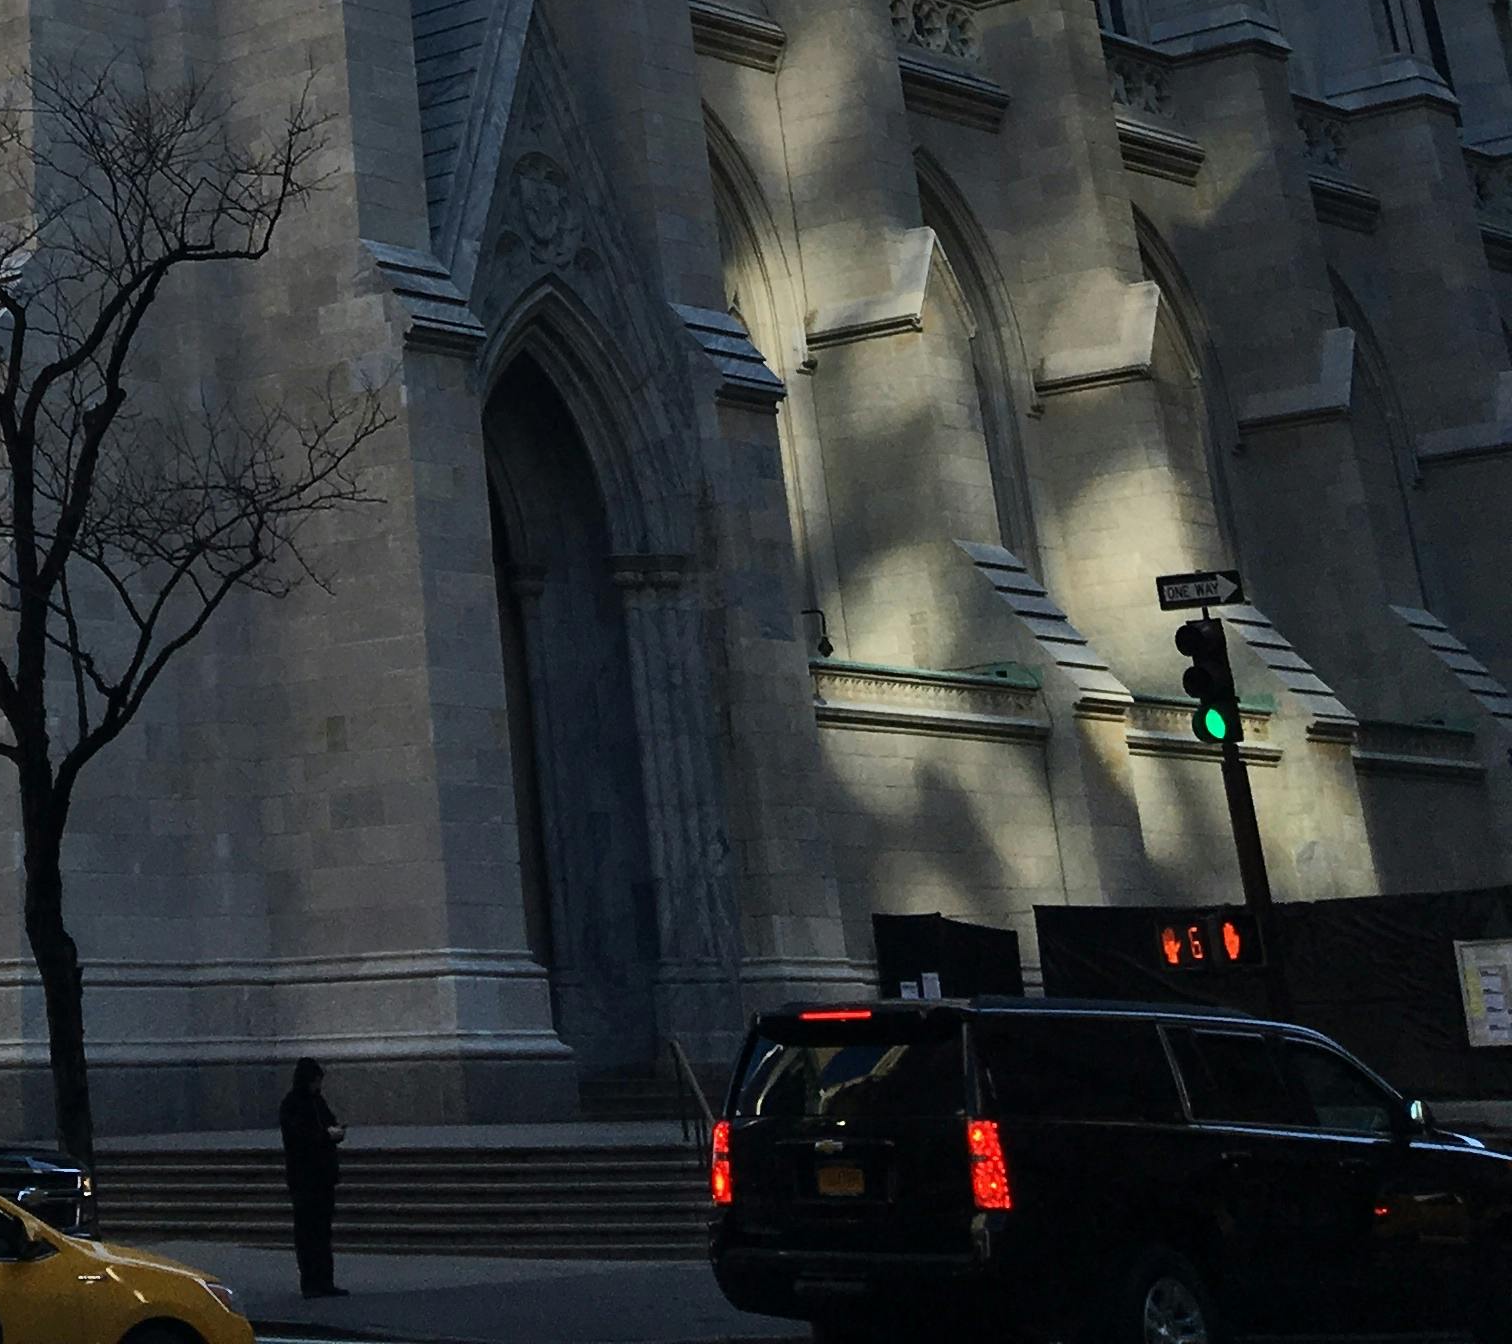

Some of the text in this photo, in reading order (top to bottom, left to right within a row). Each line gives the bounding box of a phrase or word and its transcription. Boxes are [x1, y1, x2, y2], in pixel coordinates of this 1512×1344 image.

[1167, 582, 1218, 599] ONE WAY
[1187, 925, 1204, 960] 6
